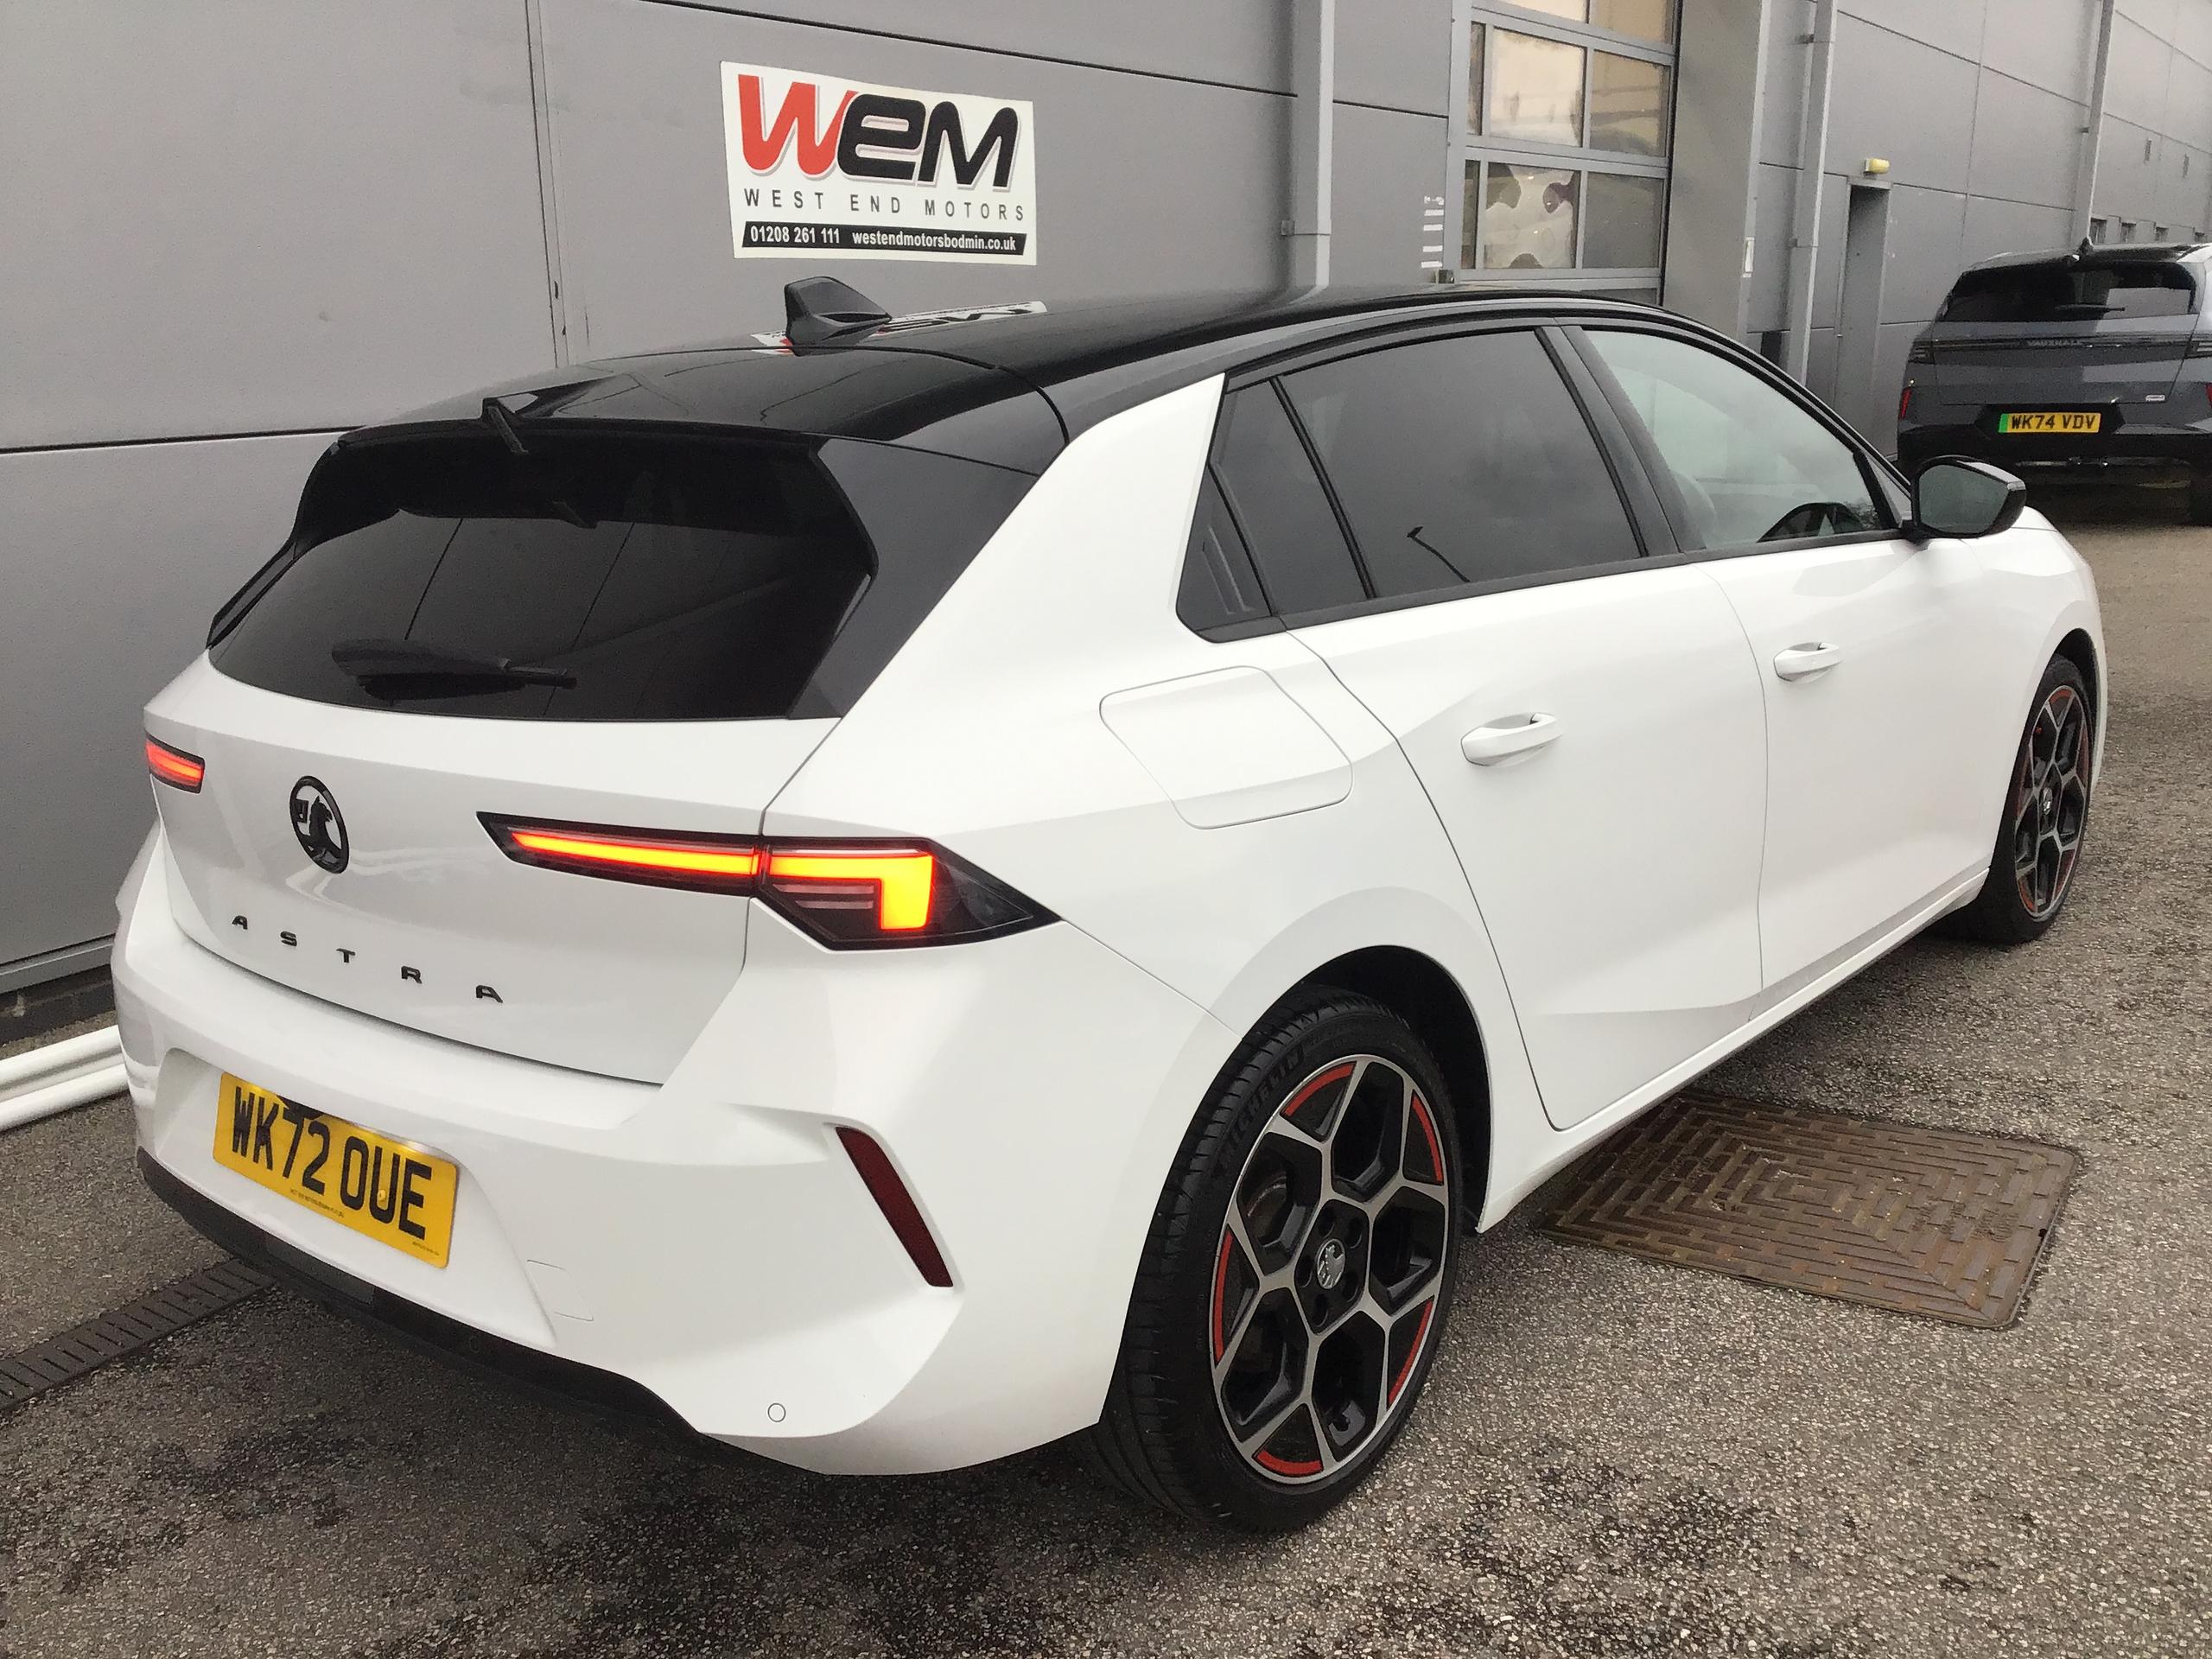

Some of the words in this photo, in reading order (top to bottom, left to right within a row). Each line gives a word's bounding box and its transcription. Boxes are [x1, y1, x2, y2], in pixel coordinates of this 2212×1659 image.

[744, 188, 824, 210] WEST
[850, 194, 900, 214] END
[925, 199, 1025, 221] MOTORS
[750, 226, 790, 245] 01208
[793, 227, 817, 244] 261
[820, 227, 840, 244] 111
[852, 231, 1017, 251] westendmotorsbodmin.co.uk
[2011, 414, 2056, 429] WK74
[2062, 414, 2097, 429] VDV
[231, 914, 504, 1004] ASTRA
[232, 1085, 331, 1197] WK72
[340, 1135, 433, 1241] OUE
